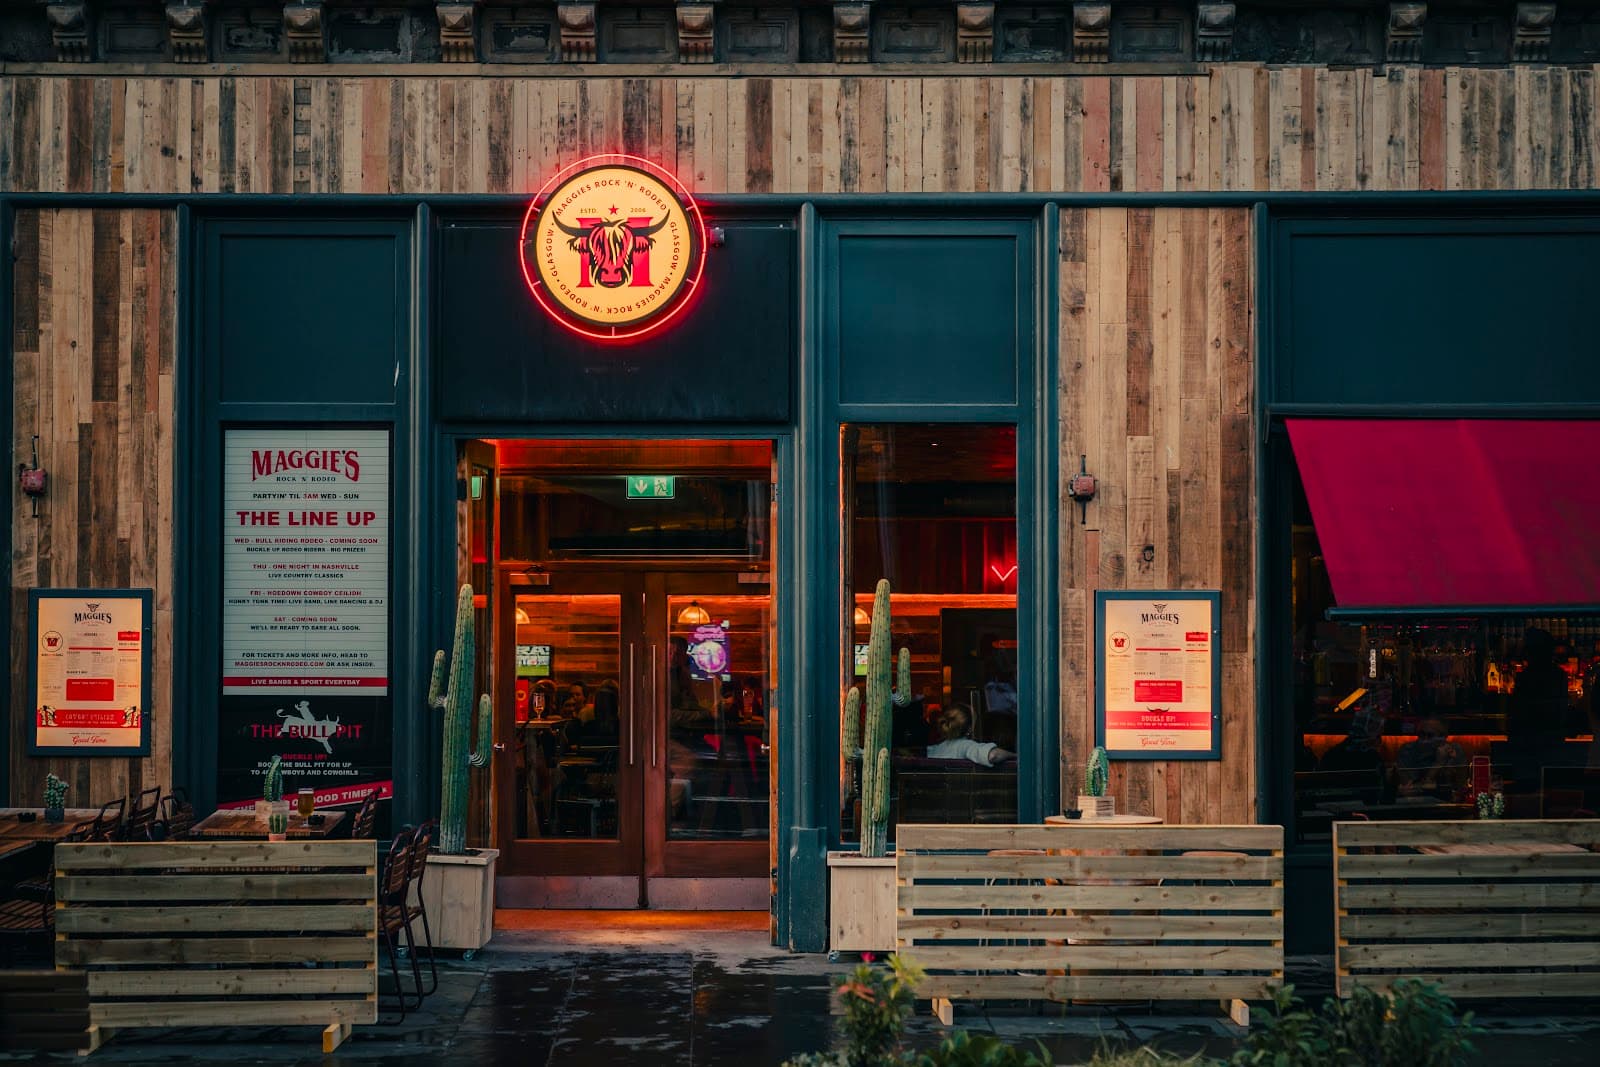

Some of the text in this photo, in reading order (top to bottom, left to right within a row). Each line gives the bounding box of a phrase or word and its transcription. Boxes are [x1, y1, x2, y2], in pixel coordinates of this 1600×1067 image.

[555, 184, 592, 217] MAGGIES
[594, 179, 621, 188] ROCK
[639, 185, 667, 211] RODEO
[546, 228, 558, 277] GLASGOW
[669, 221, 681, 271] GLASGOW
[559, 283, 588, 309] RODEO
[636, 276, 671, 309] MAGGIES
[606, 304, 633, 314] ROCK
[251, 450, 360, 482] MAGGIE'S
[236, 511, 376, 526] THE LINE UP
[249, 724, 363, 739] THE BULL PIT
